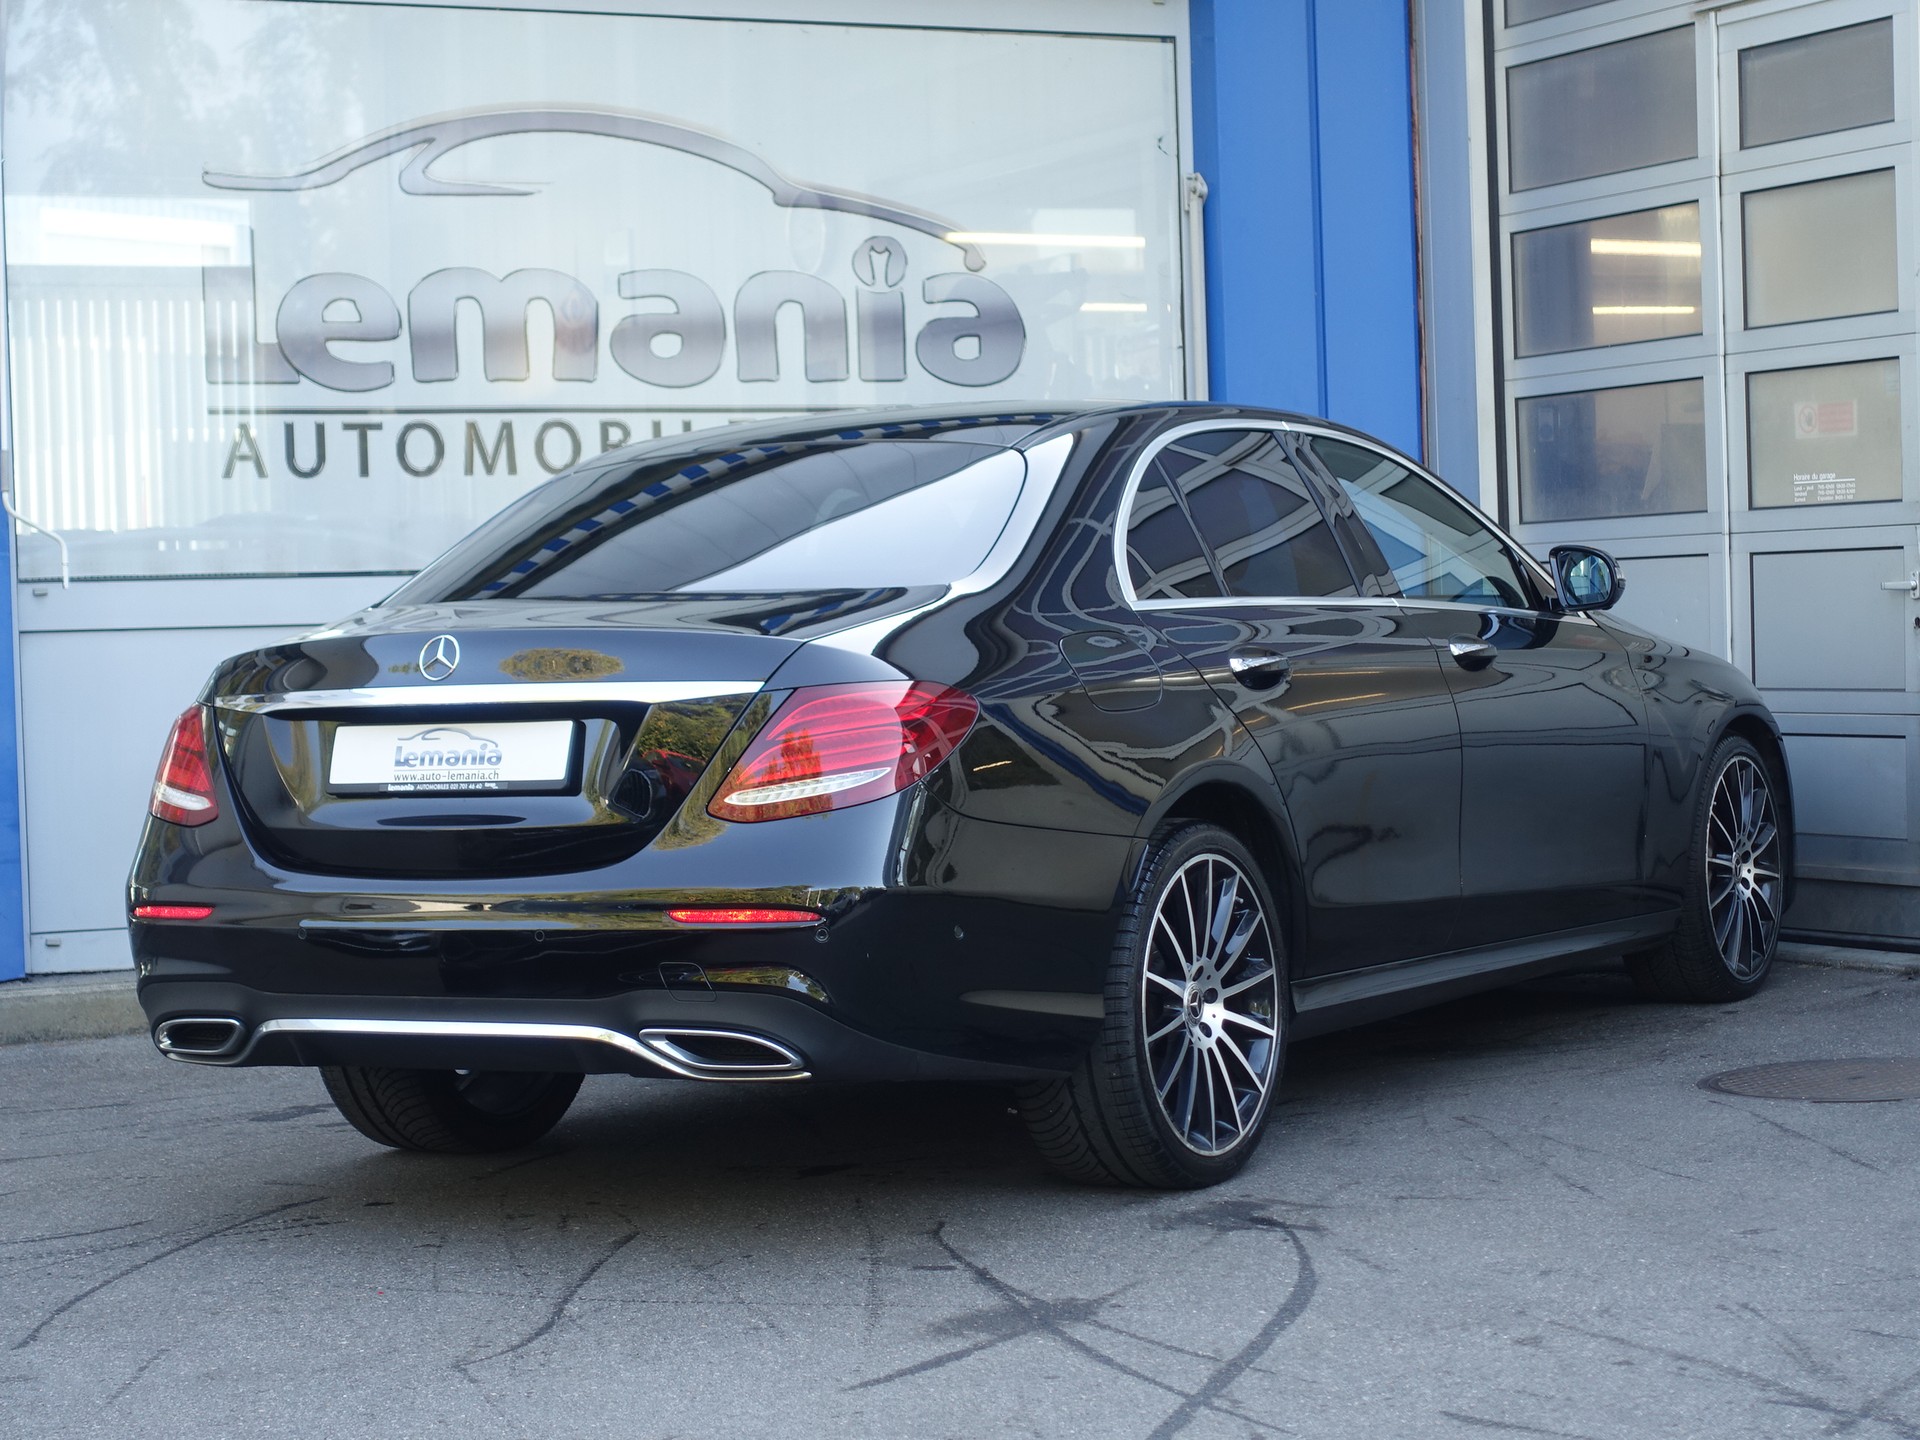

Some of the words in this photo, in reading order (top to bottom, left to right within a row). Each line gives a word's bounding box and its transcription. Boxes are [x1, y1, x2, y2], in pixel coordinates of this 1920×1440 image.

[202, 227, 1026, 393] Lemania
[222, 419, 735, 479] AUTOMOB
[394, 743, 502, 768] Lemania
[394, 769, 499, 781] www.auto-lemania.ch
